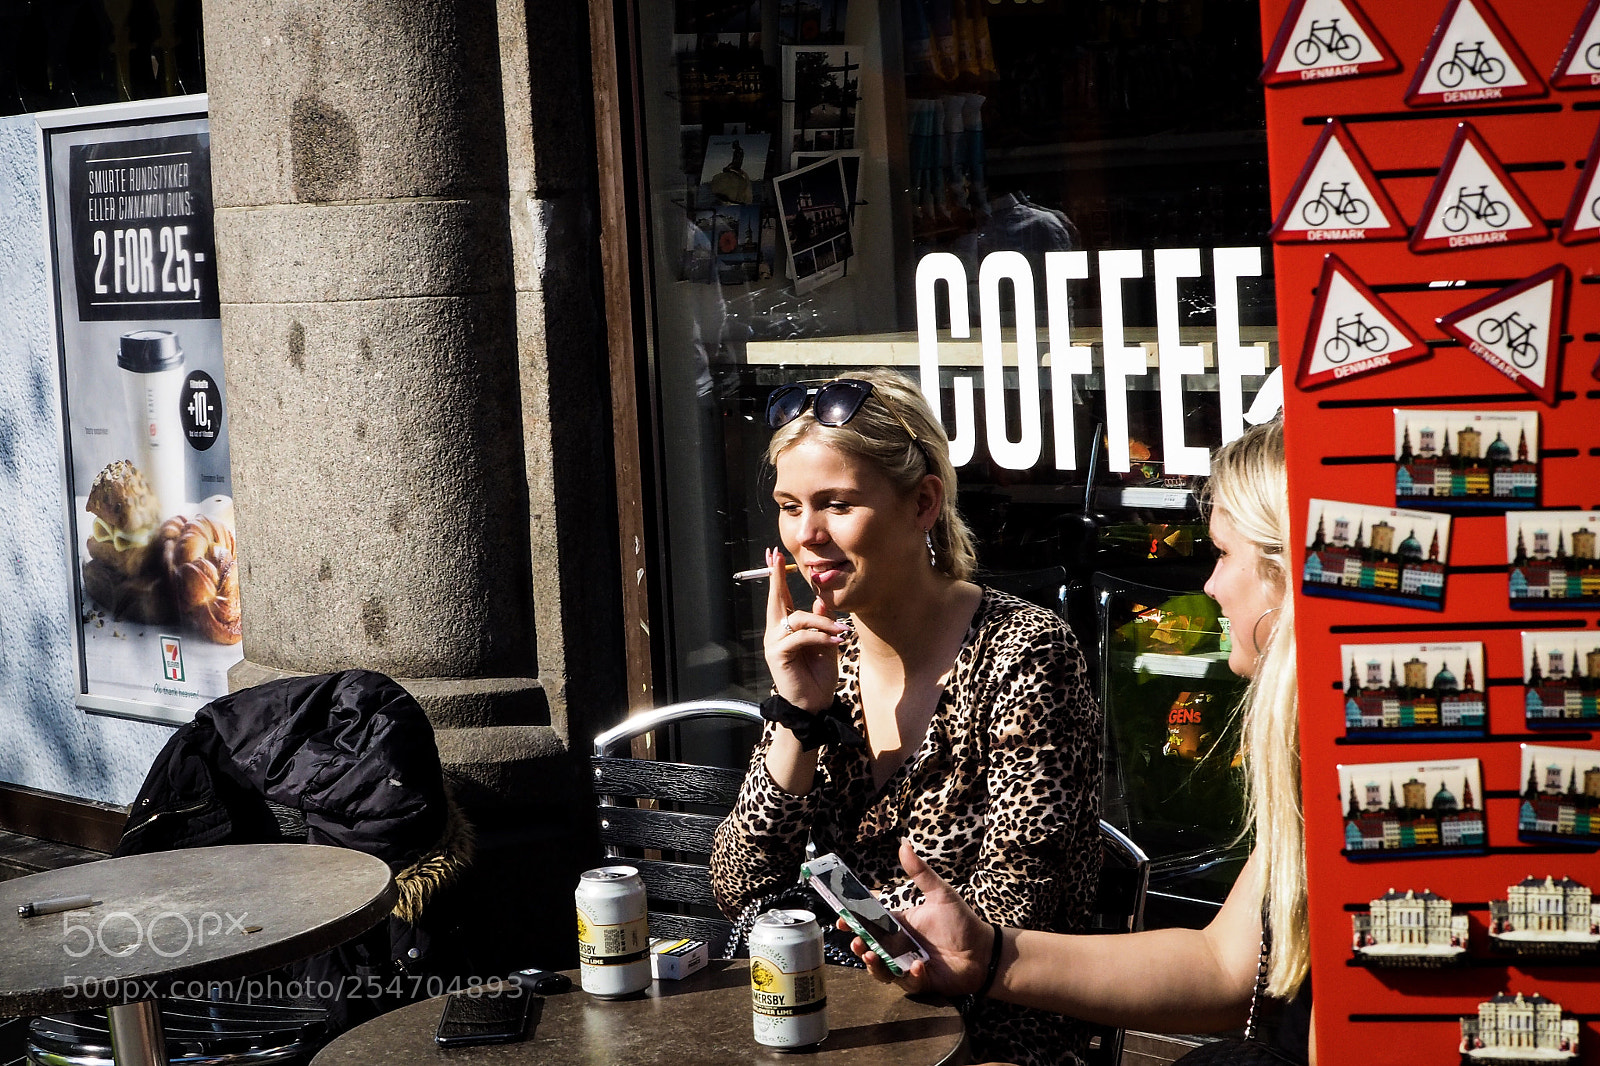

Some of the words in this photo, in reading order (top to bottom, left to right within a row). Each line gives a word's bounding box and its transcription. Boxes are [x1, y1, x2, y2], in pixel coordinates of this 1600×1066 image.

[1300, 64, 1359, 81] DENMARK
[1443, 88, 1503, 104] DENMARK
[88, 168, 126, 194] SMURTE
[129, 162, 189, 191] RUNDSTYKKER
[88, 197, 115, 222] ELLER
[118, 193, 164, 220] CINNAMON
[1306, 229, 1366, 241] DENMARK
[1449, 231, 1509, 248] DENMARK
[93, 230, 108, 294] 2
[114, 227, 155, 294] FOR
[159, 226, 205, 300] 25,-
[915, 246, 1265, 476] COFFEE
[1333, 354, 1392, 379] DENMARK
[1469, 341, 1522, 381] DENMARK
